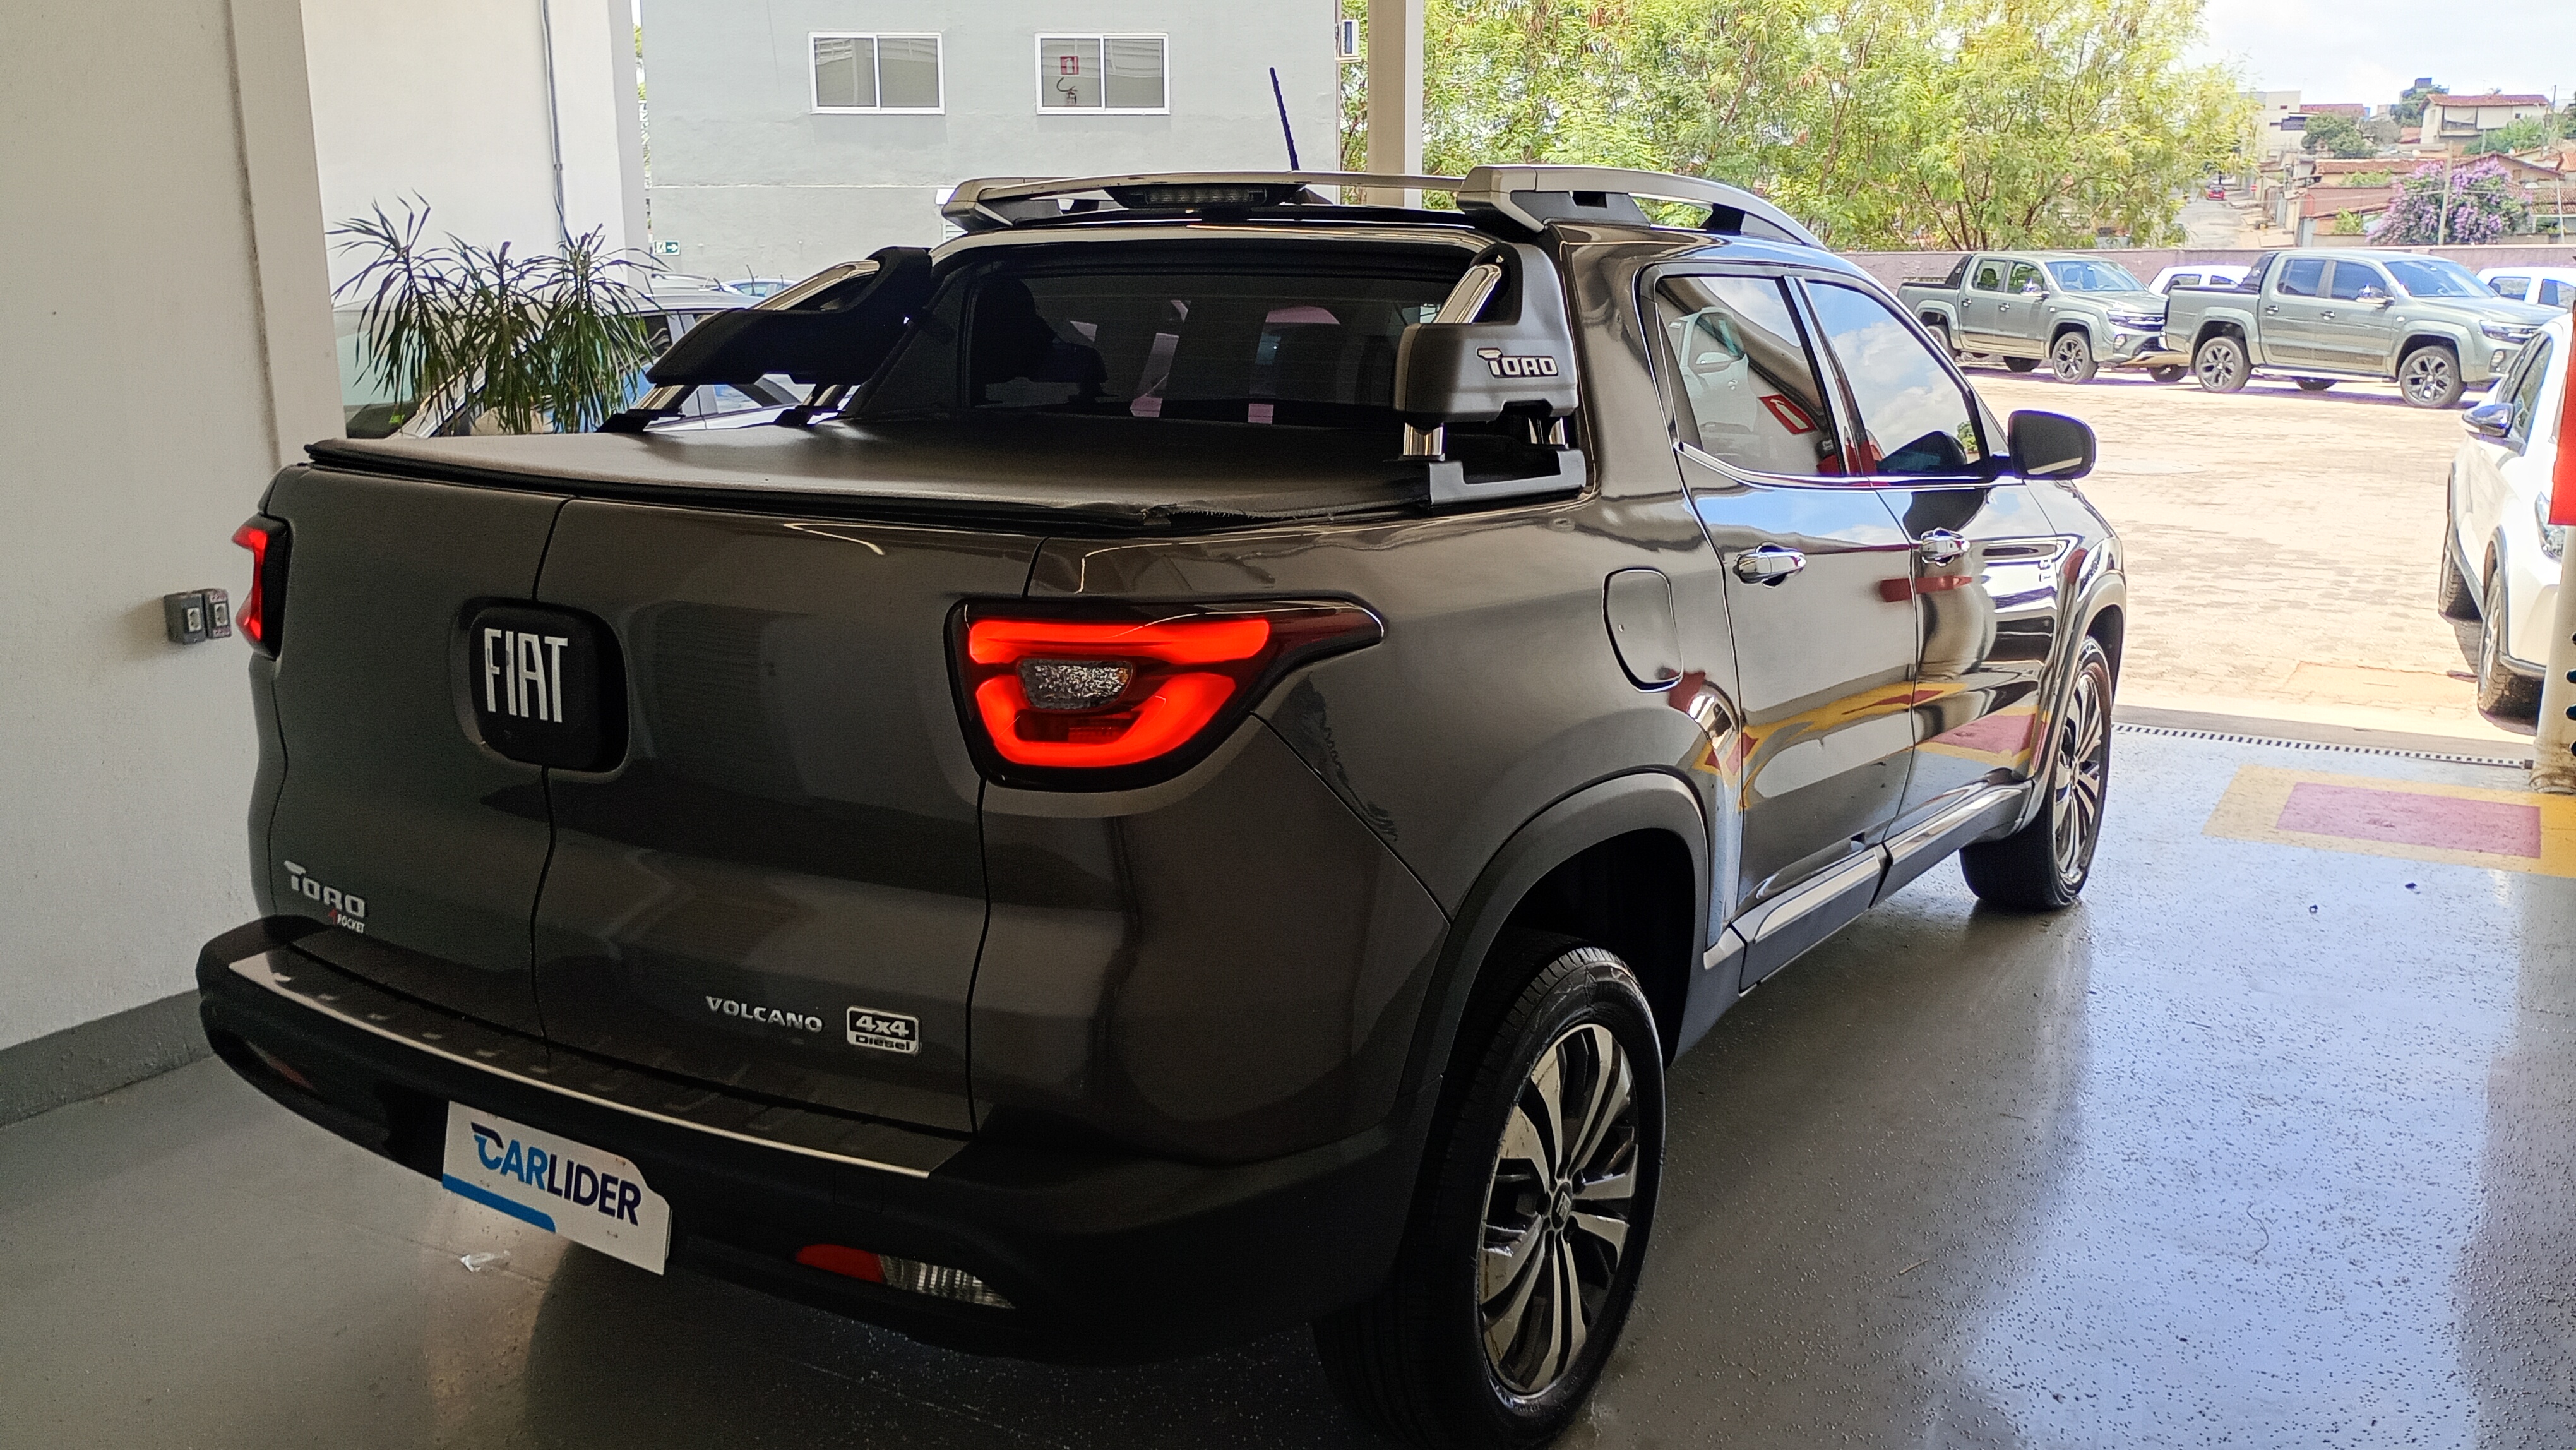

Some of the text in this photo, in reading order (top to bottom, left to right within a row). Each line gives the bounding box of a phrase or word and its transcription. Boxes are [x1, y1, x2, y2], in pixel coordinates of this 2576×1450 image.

[1477, 348, 1558, 376] TORO
[484, 628, 568, 723] FIAT
[284, 860, 365, 918] TORO
[705, 995, 823, 1033] VOLCANO
[856, 1015, 909, 1037] 4x4
[856, 1034, 910, 1051] Diesel
